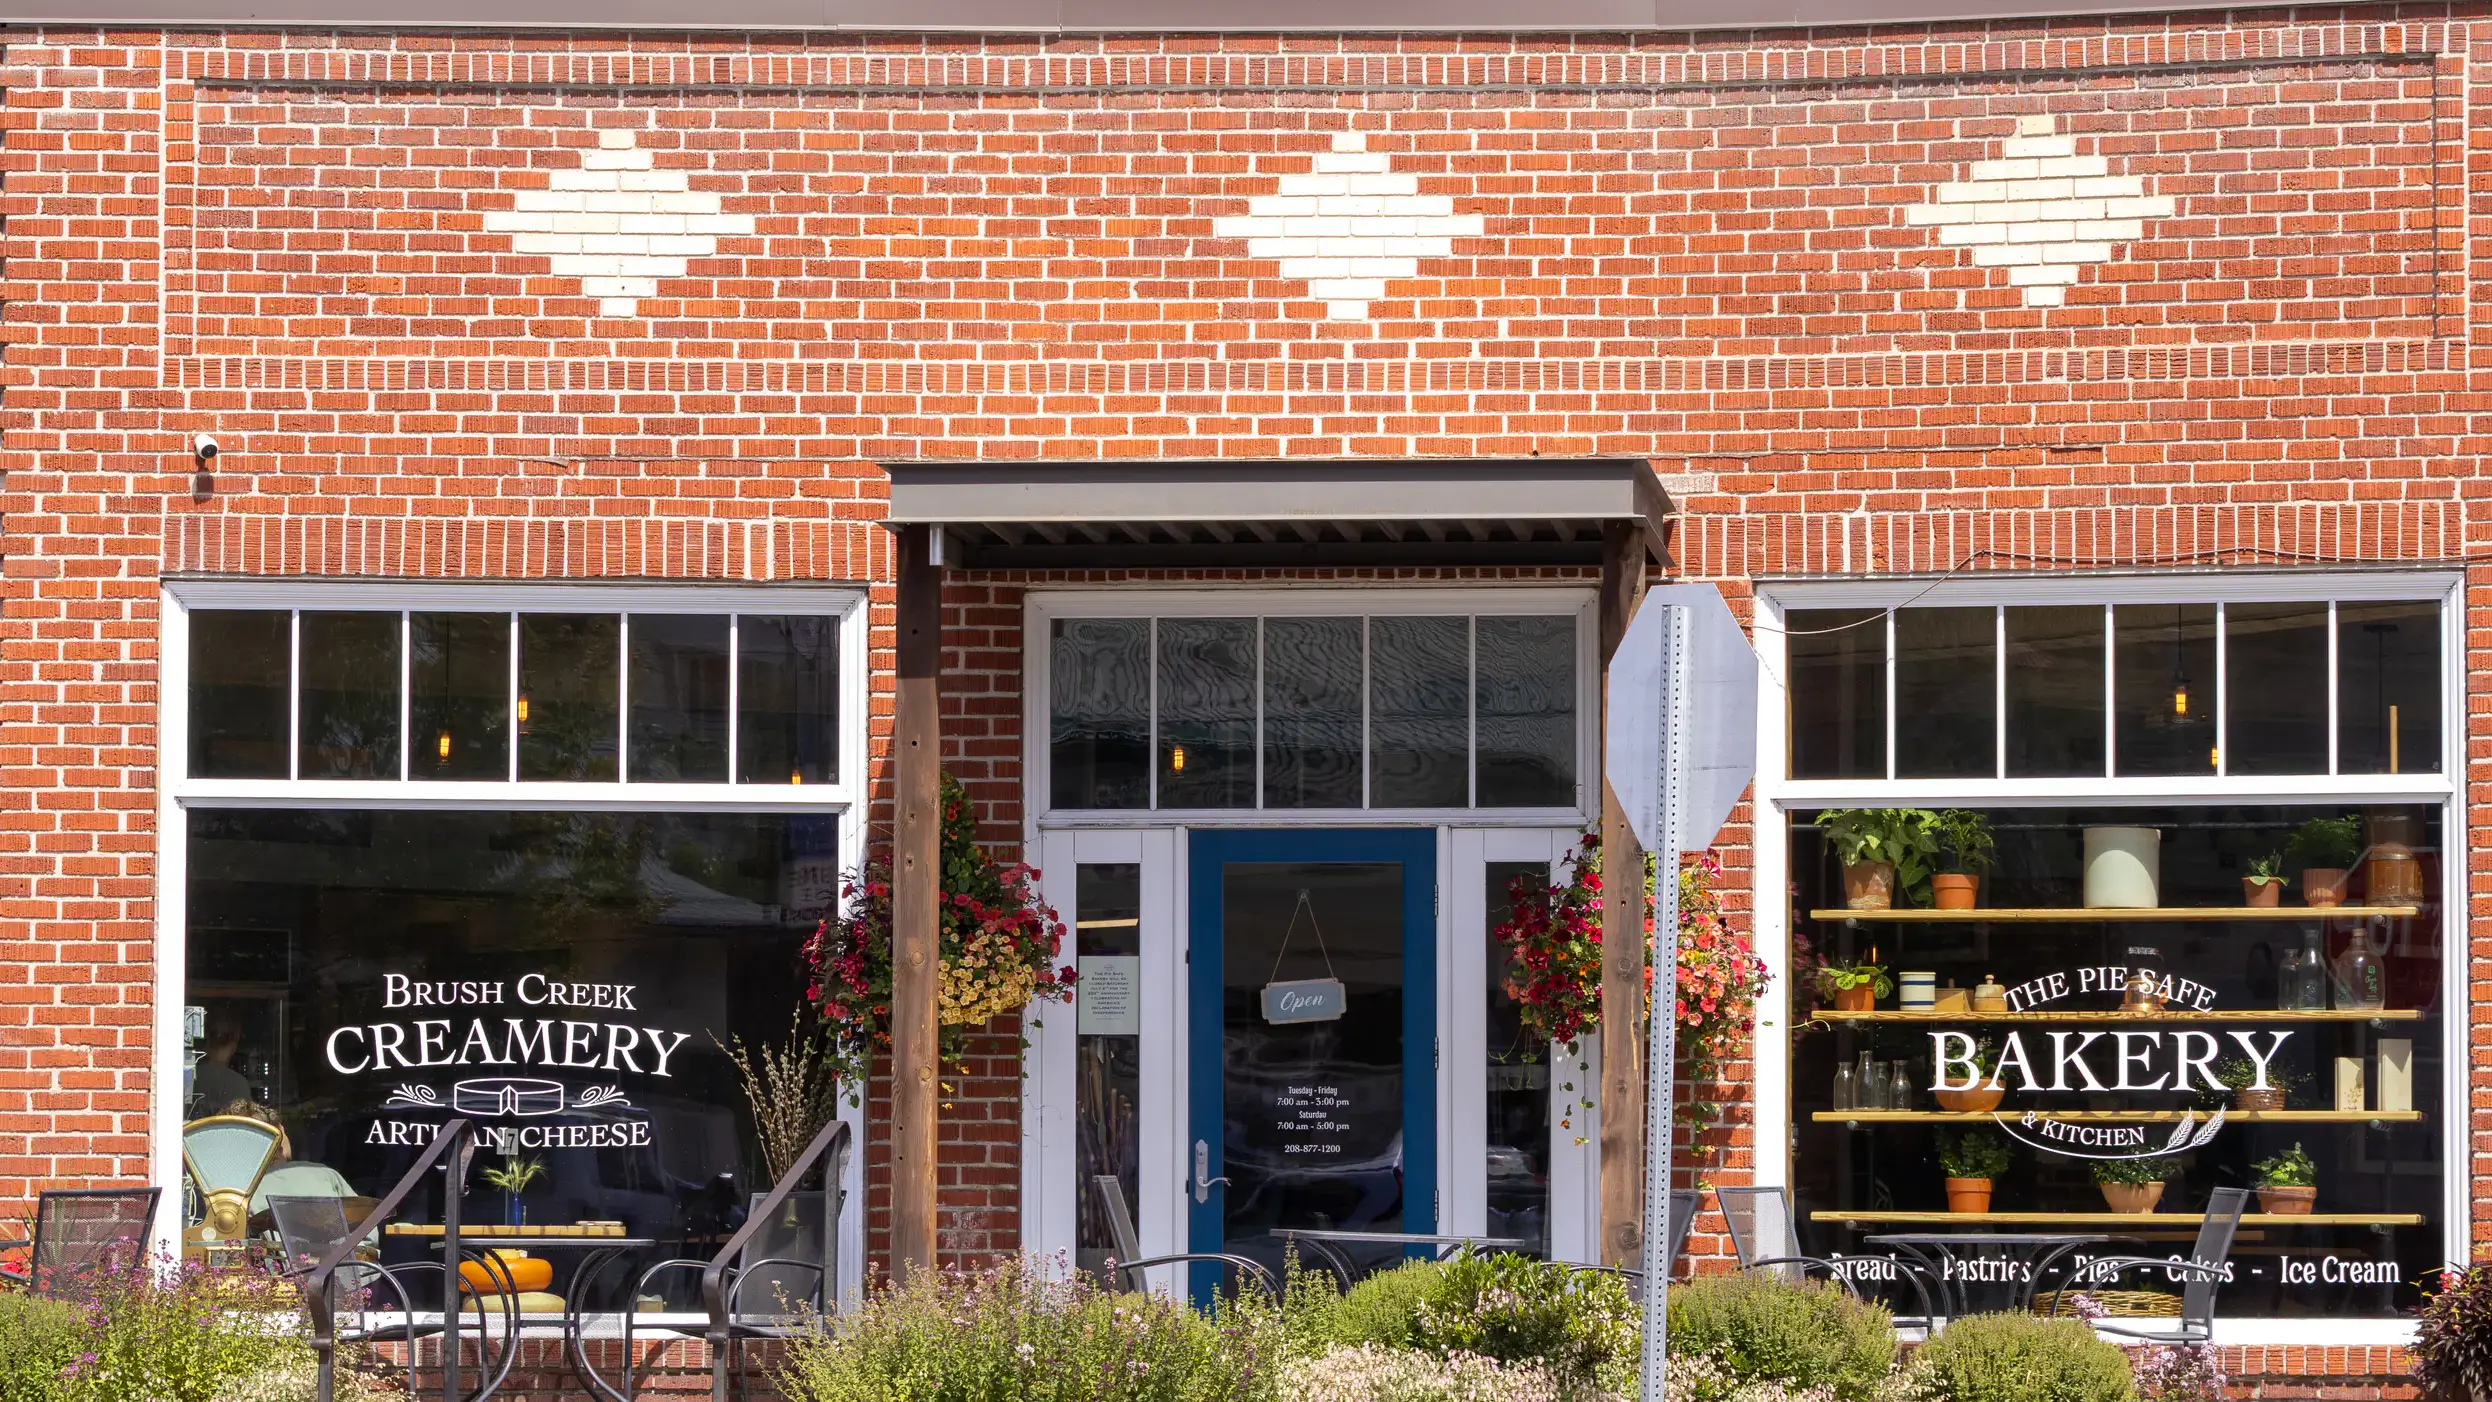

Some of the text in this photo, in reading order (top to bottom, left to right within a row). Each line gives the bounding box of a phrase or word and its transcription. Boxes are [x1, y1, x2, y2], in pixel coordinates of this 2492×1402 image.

[382, 973, 637, 1011] BRUSH CREEK
[1280, 991, 1325, 1012] Open
[2003, 967, 2217, 1014] THE PIE SAFE
[326, 1017, 691, 1077] CREAMERY
[1927, 1031, 2294, 1092] BAKERY
[1288, 1086, 1313, 1097] Tuesday
[1318, 1086, 1338, 1097] Friday
[364, 1119, 652, 1148] ARTIN CHEESE
[1277, 1122, 1294, 1130] 7:00
[1316, 1122, 1334, 1130] 5:00
[1336, 1124, 1349, 1132] pm
[2021, 1110, 2145, 1146] & KITCHEN
[1284, 1144, 1341, 1153] 208-877-1200
[2074, 1255, 2119, 1283] Pies
[2281, 1256, 2316, 1284] Ice
[2322, 1256, 2401, 1284] Cream
